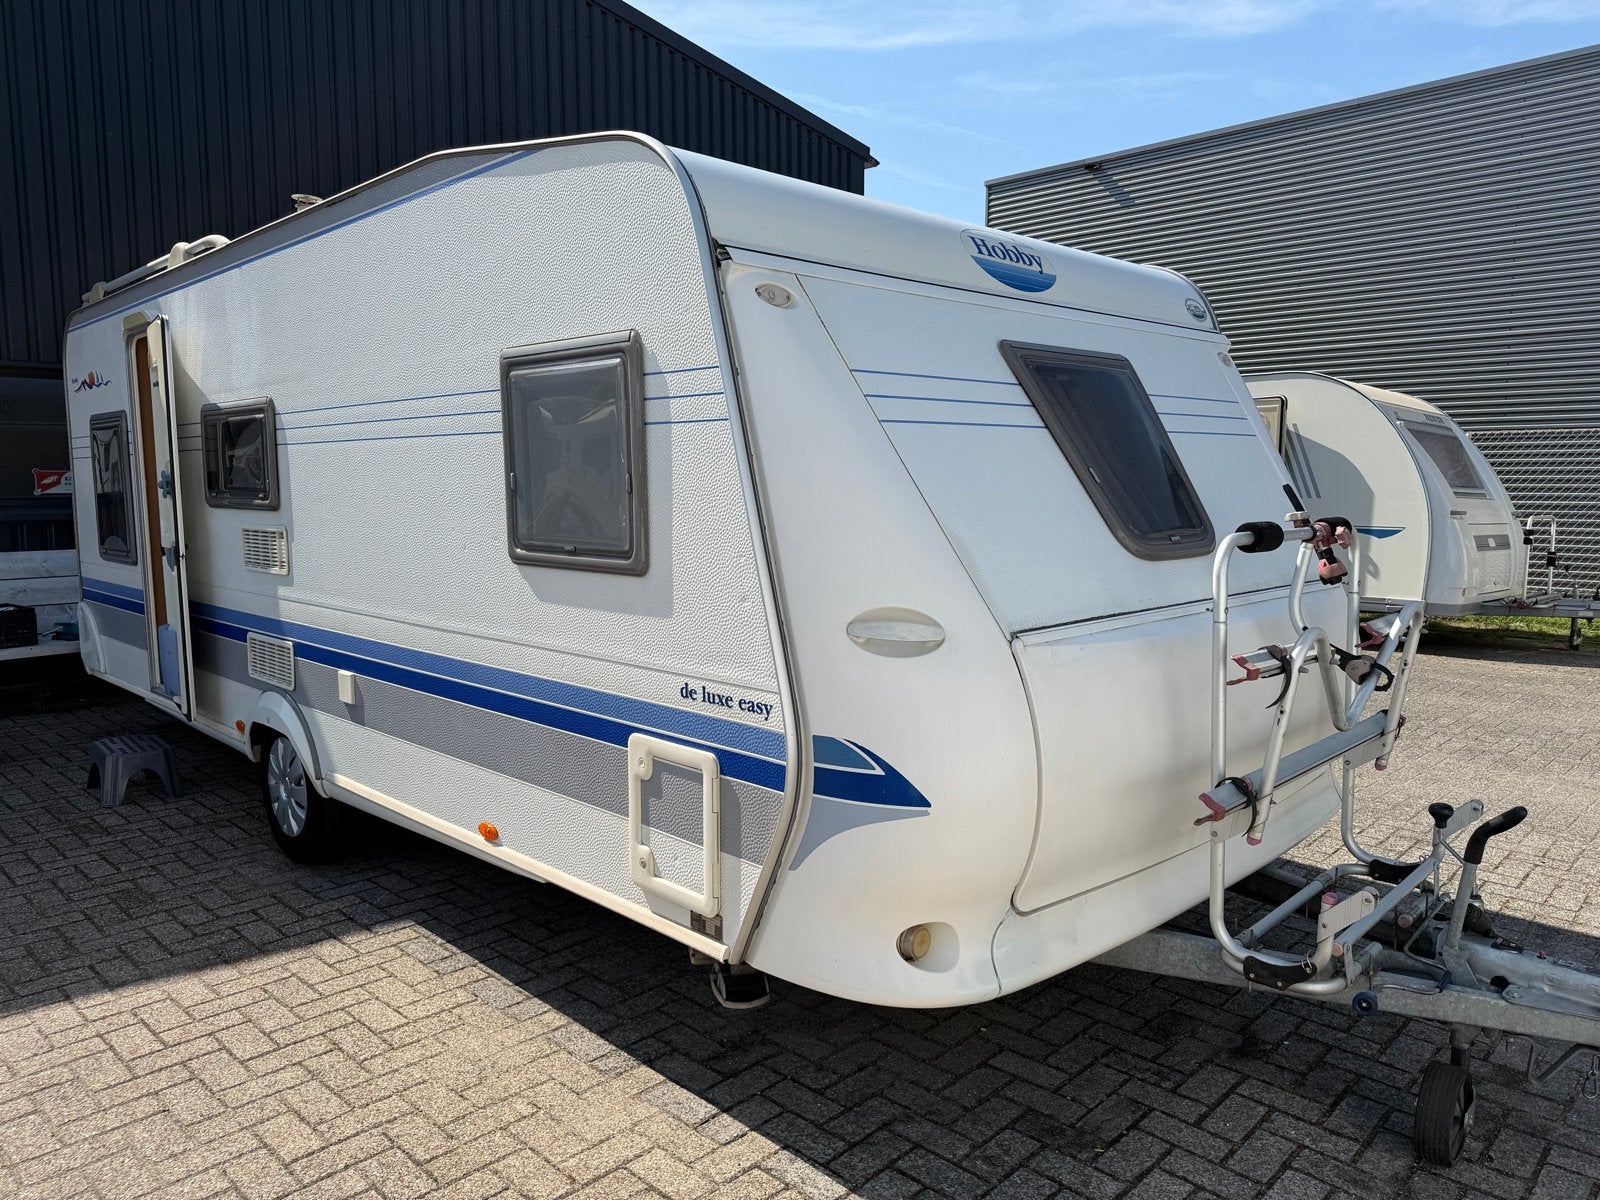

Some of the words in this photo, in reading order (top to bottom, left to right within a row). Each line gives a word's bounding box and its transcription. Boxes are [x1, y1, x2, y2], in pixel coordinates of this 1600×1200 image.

[967, 235, 1044, 275] Hobby
[680, 682, 698, 701] de
[701, 685, 734, 709] luxe
[738, 698, 773, 721] easy
